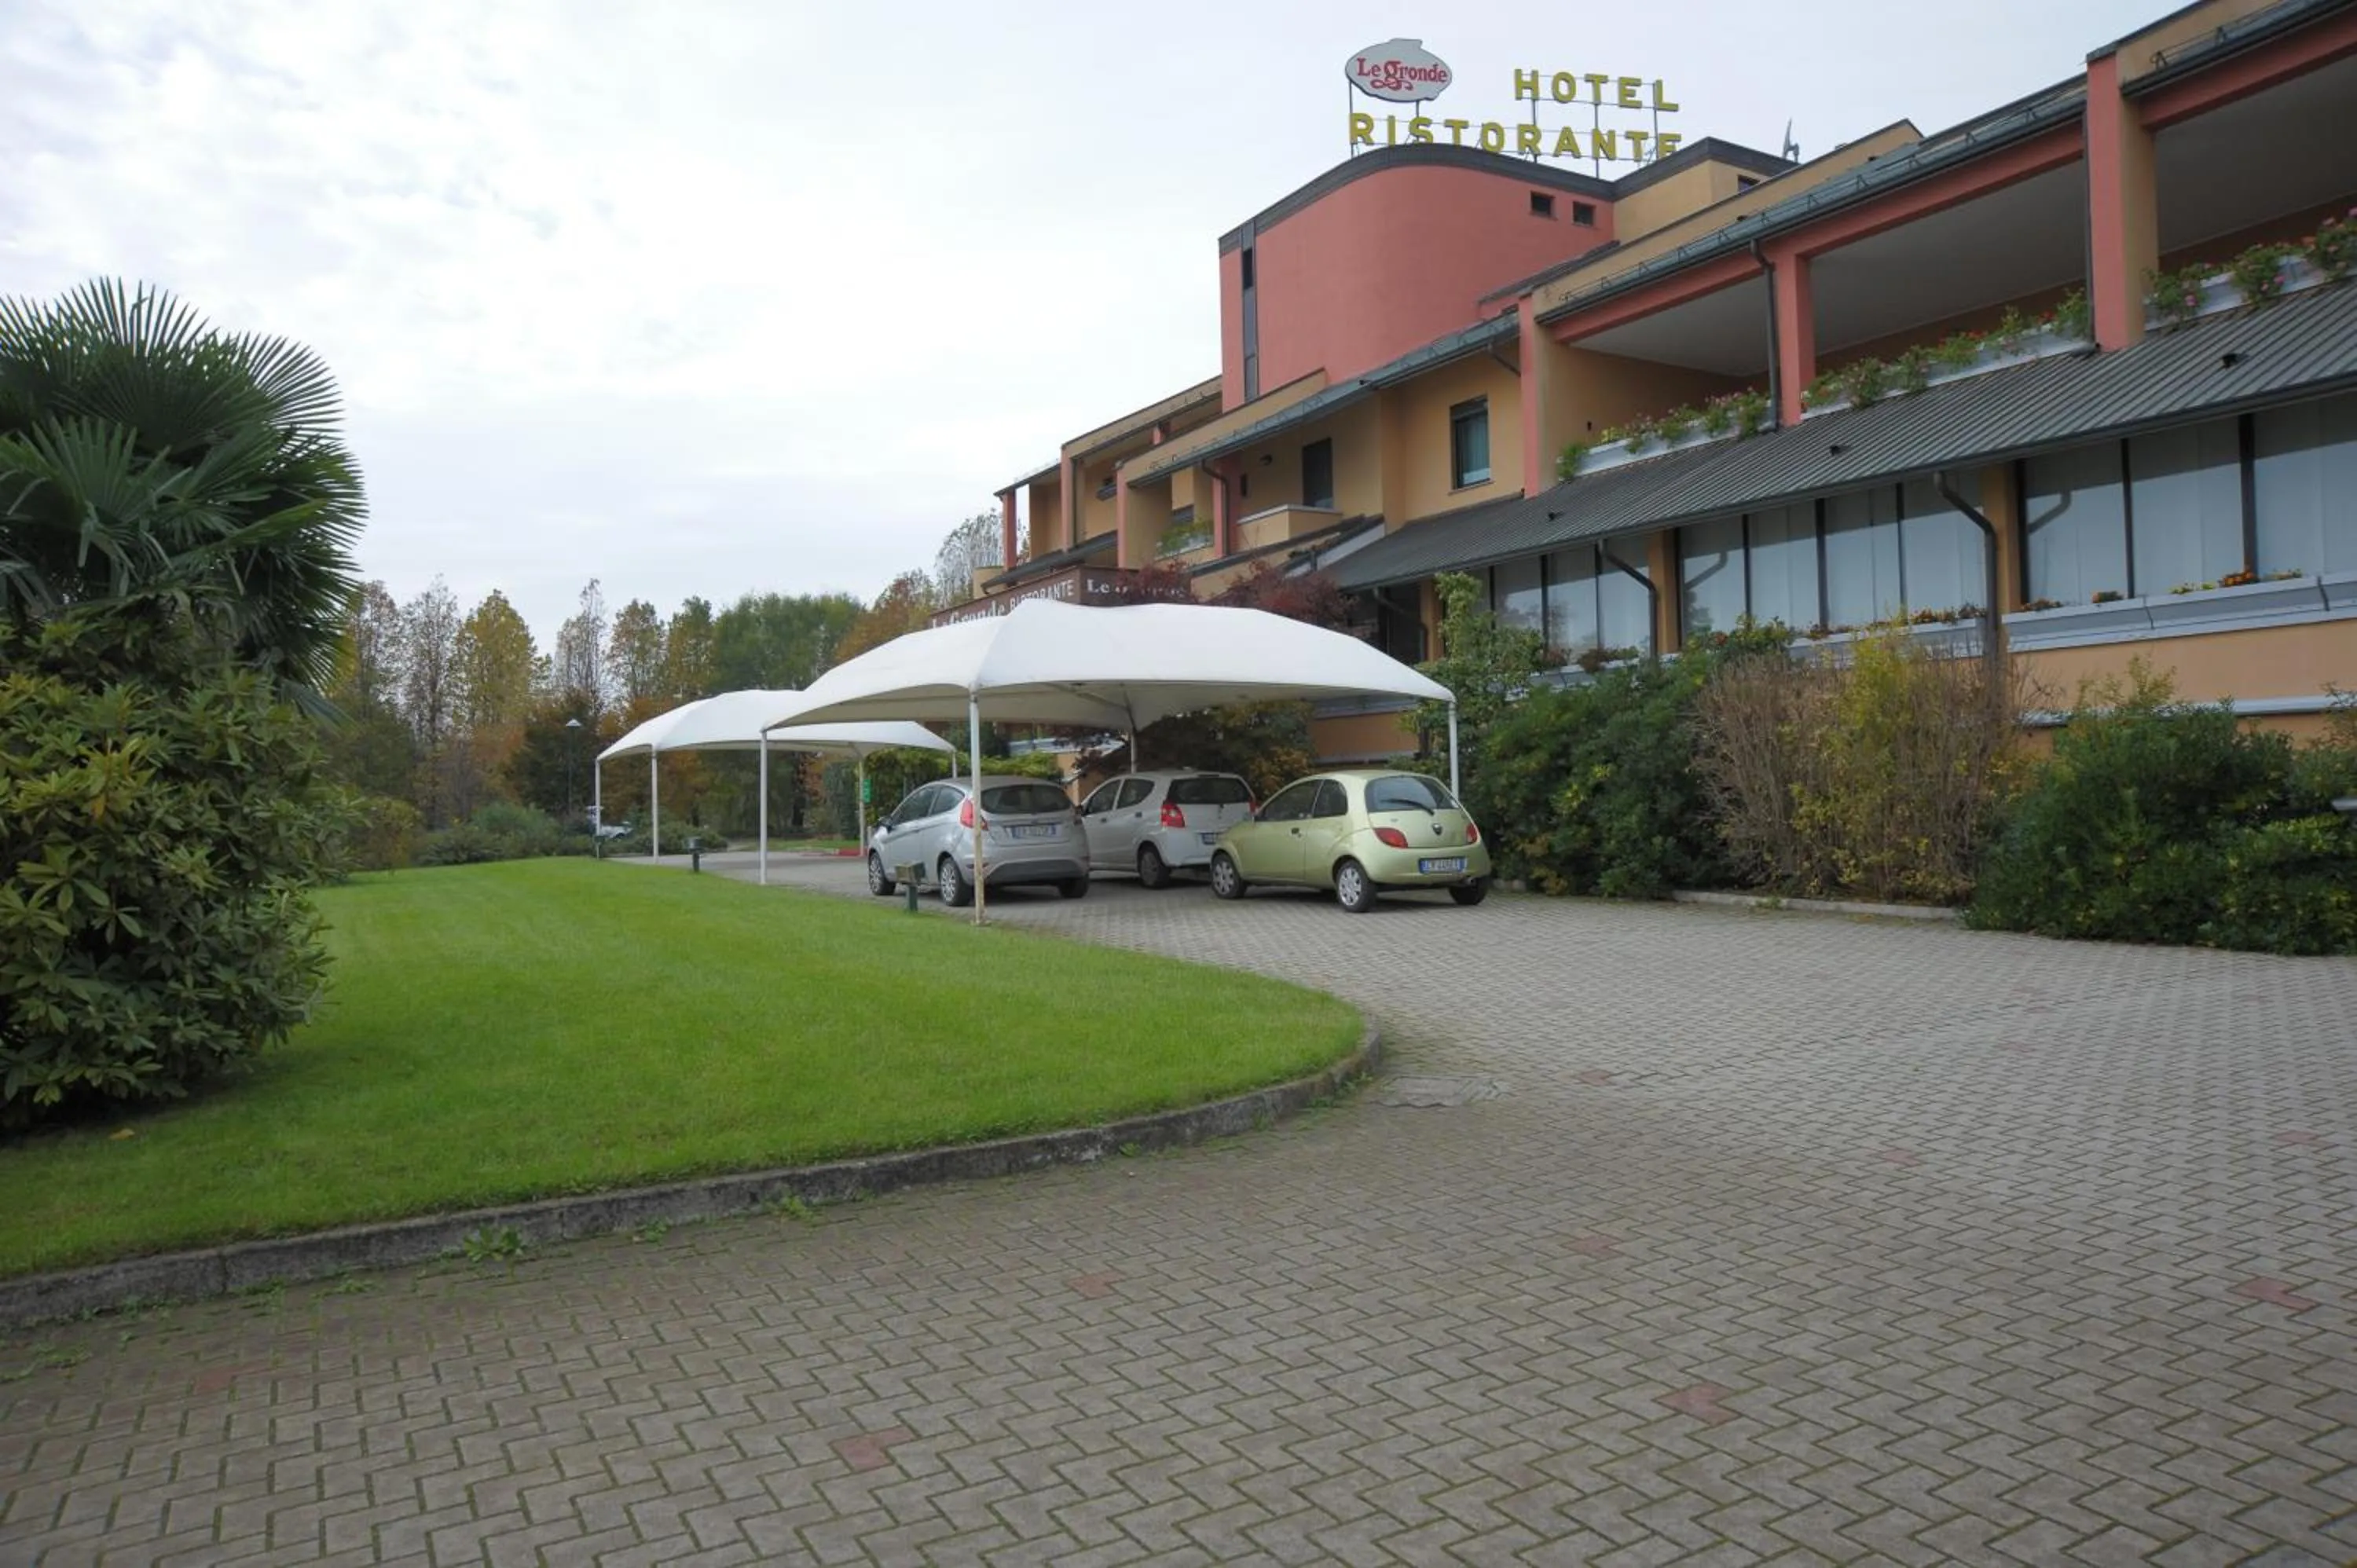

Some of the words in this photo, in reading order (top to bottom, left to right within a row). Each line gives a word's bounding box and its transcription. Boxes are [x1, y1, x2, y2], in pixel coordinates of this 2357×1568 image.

[1357, 57, 1381, 77] Le
[1515, 69, 1679, 112] HOTEL
[1350, 113, 1681, 162] RISTORANTE
